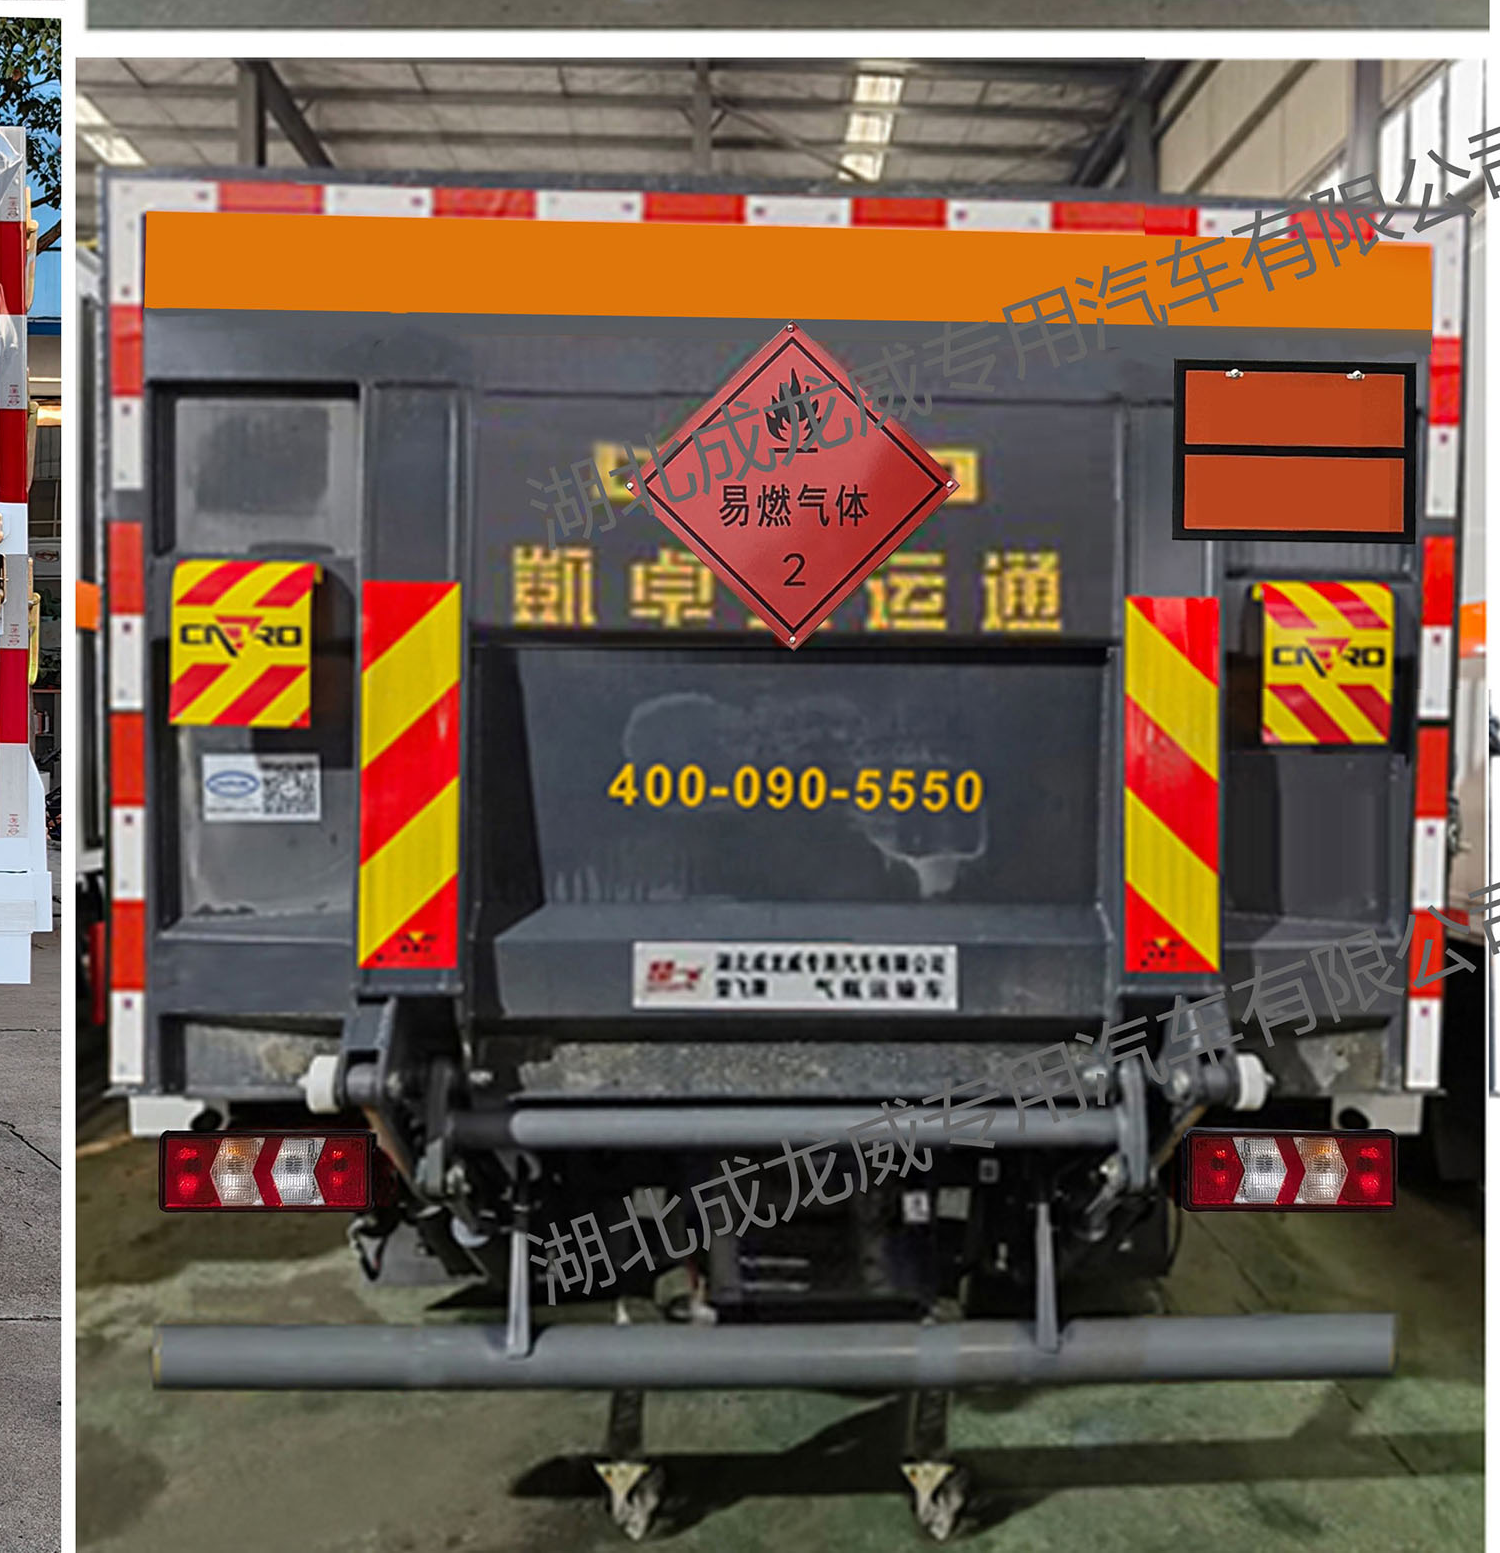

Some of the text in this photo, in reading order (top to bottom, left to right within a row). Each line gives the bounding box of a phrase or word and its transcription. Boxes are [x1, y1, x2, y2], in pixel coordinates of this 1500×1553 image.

[718, 483, 870, 528] 易燃气体
[782, 552, 807, 587] 2
[608, 763, 984, 812] 400-090-5550
